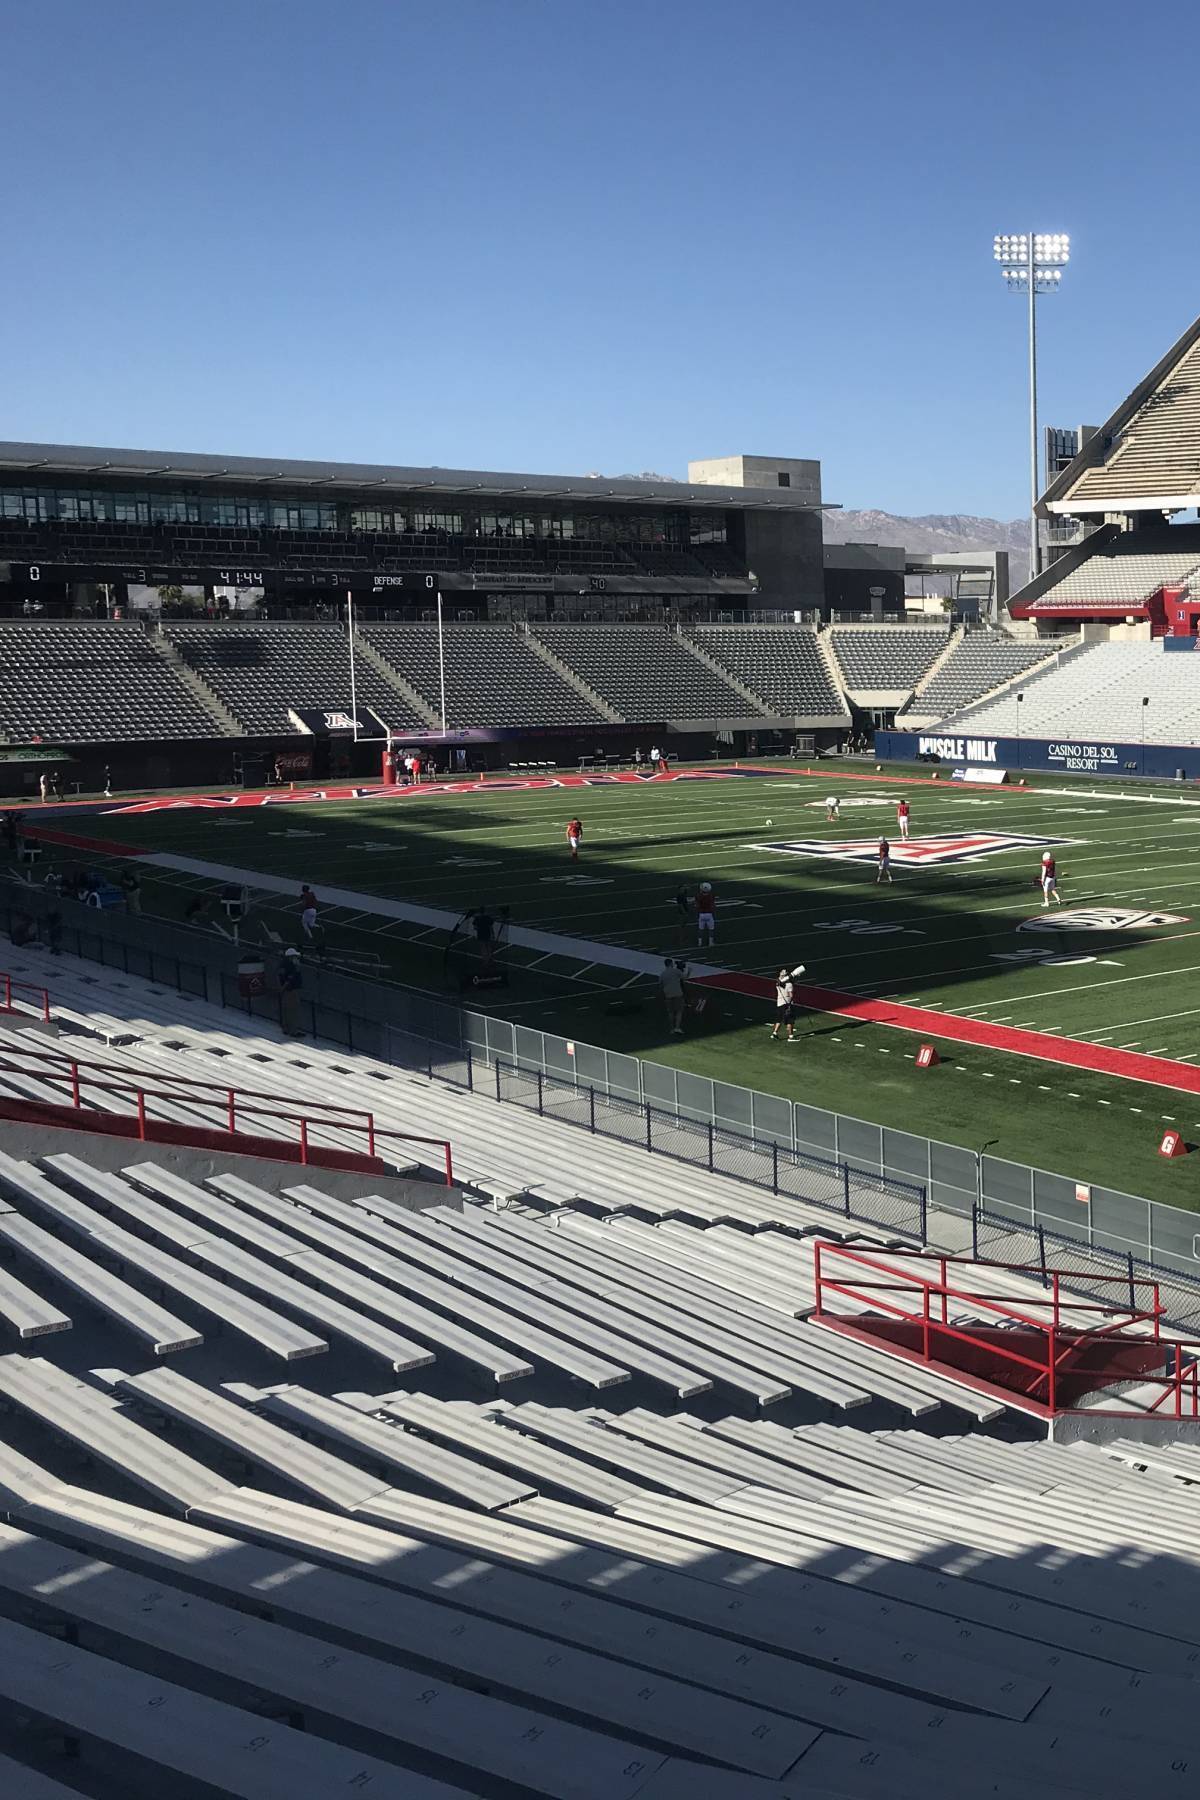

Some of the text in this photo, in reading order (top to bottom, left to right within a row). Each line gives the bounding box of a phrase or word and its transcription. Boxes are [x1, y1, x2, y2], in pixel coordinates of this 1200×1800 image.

[29, 566, 41, 582] 0
[138, 570, 147, 582] 3
[220, 571, 264, 586] 41:44
[331, 574, 339, 587] 3
[373, 576, 404, 587] DEFENSE
[425, 575, 434, 588] 0
[591, 578, 606, 590] 40
[919, 737, 998, 762] MUSCLE MILK
[1048, 744, 1118, 760] CASINO DEL SOL
[1066, 758, 1100, 771] RESORT
[811, 919, 905, 935] 30
[989, 947, 1098, 967] 20
[1160, 1135, 1176, 1155] G
